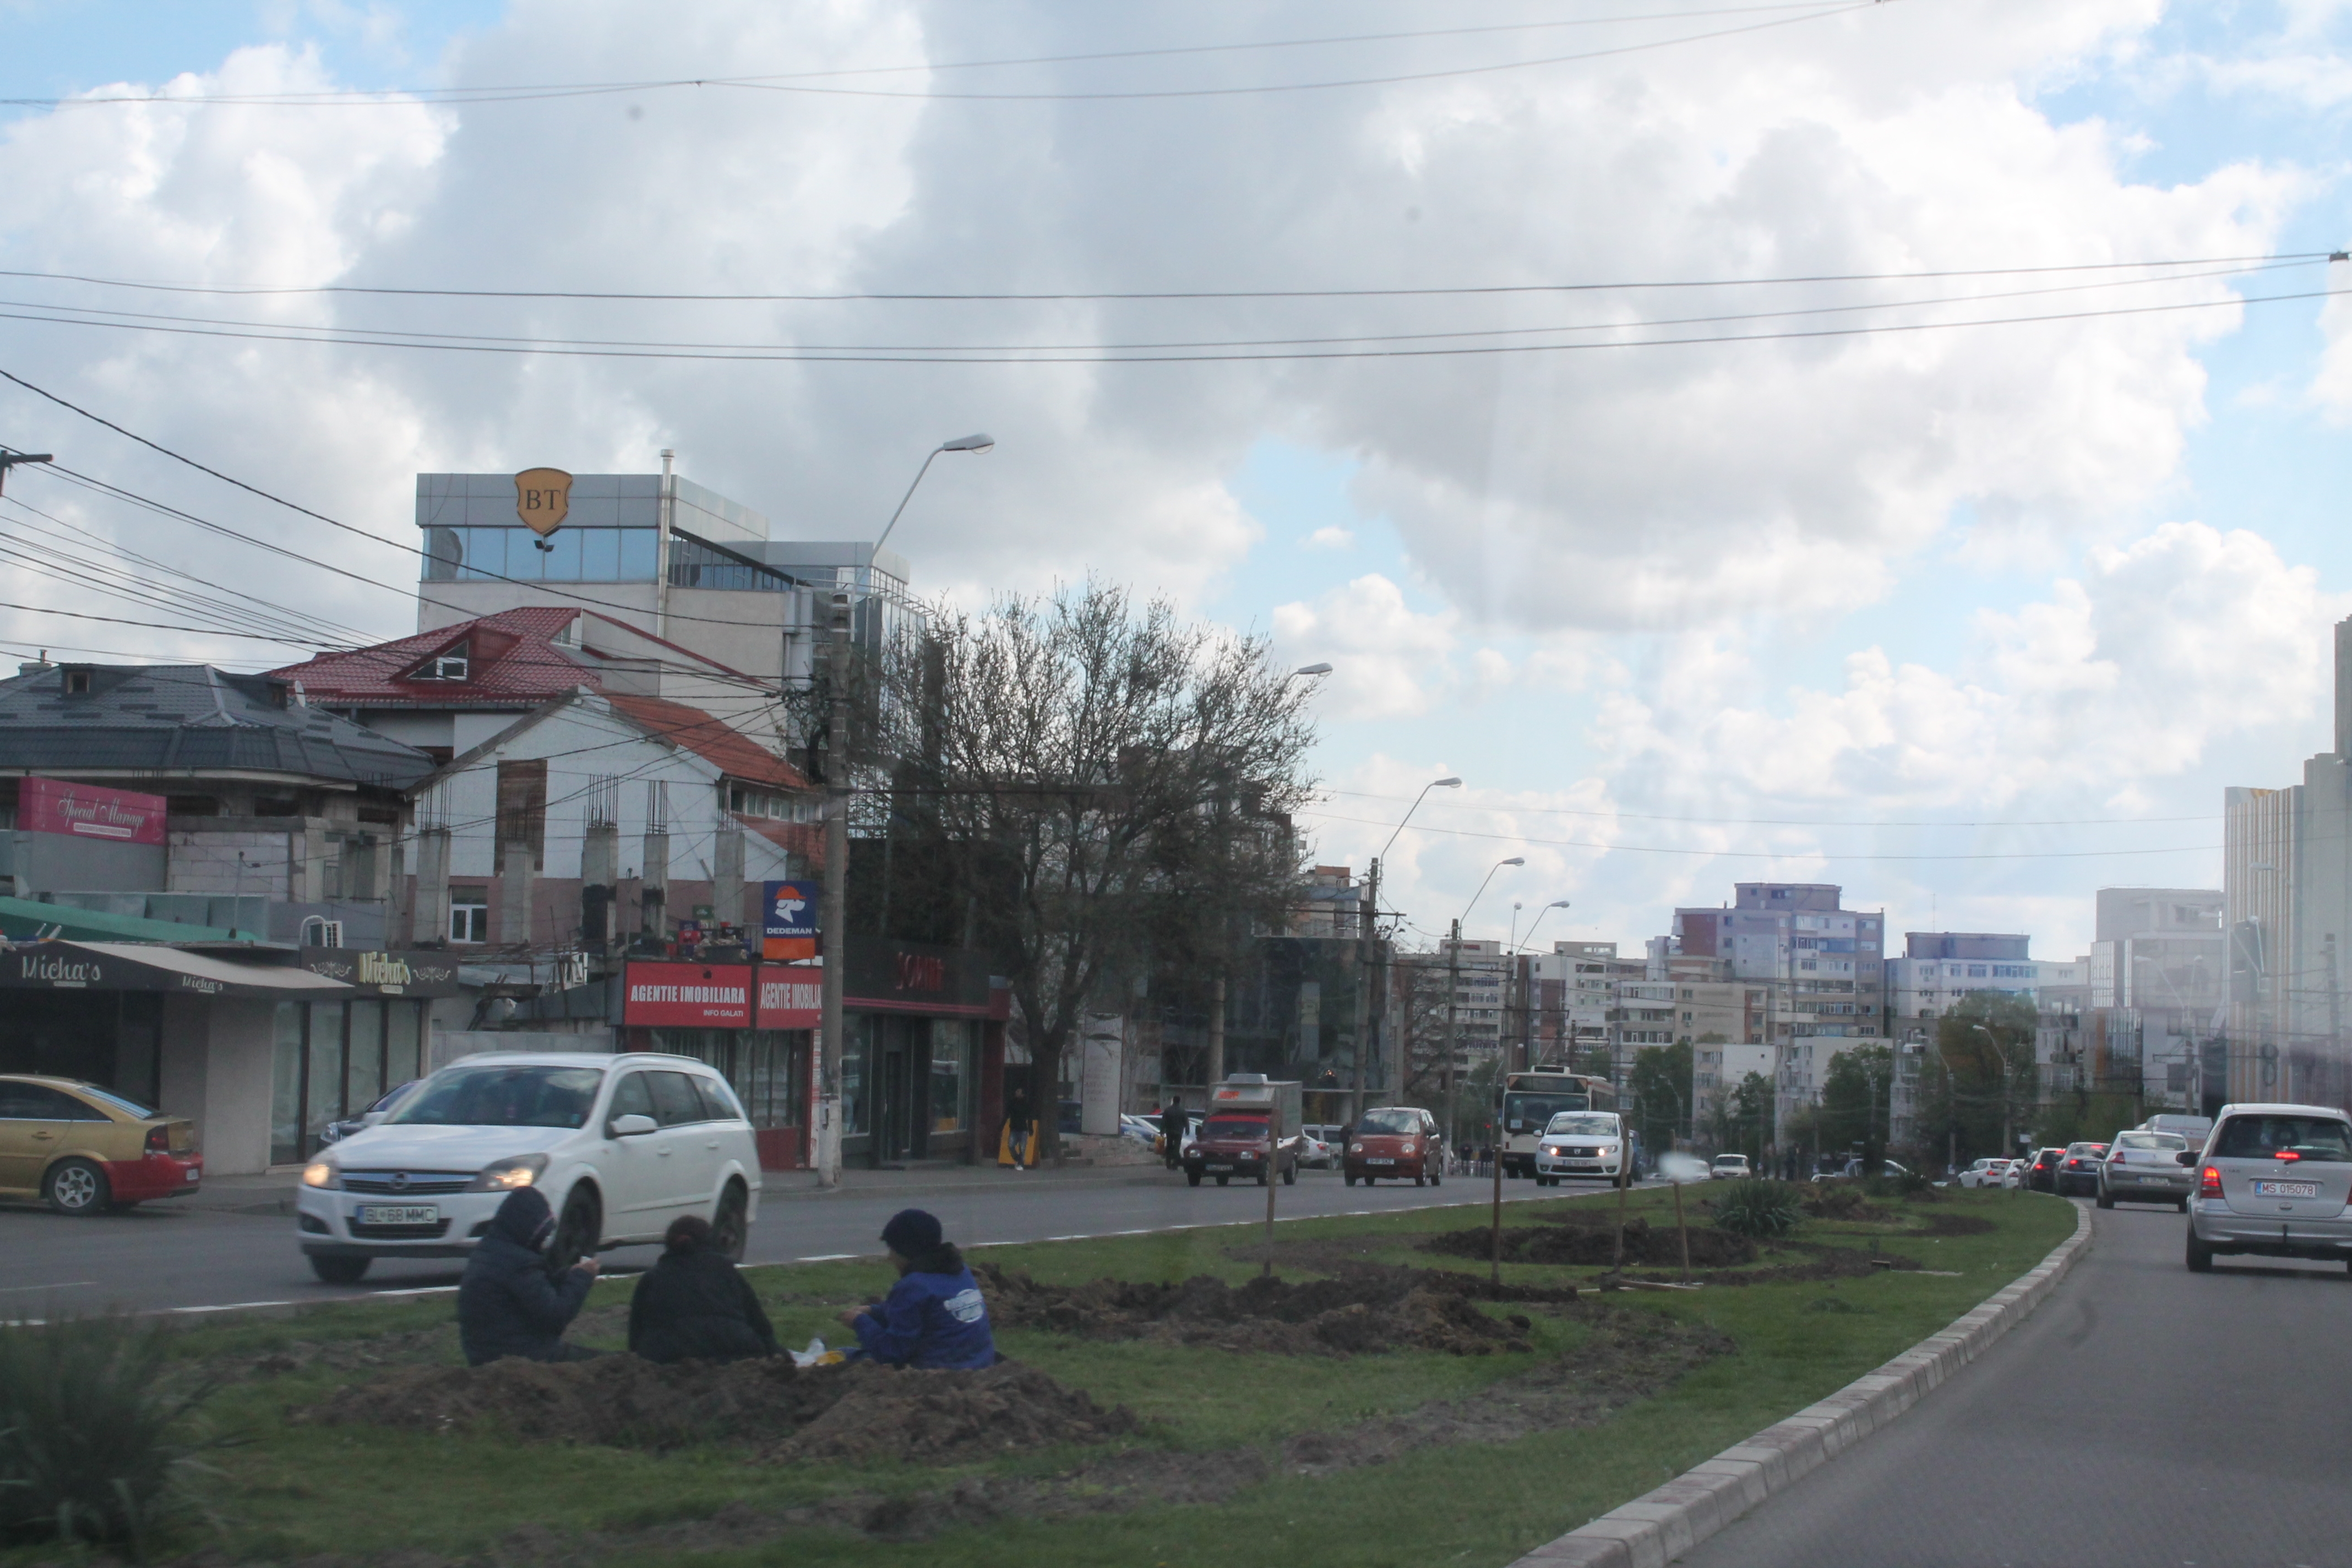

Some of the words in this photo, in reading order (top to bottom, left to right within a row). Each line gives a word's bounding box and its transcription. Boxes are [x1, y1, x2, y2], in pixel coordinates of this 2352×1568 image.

[526, 489, 560, 510] BT
[57, 789, 99, 826] Special
[100, 798, 145, 837] Mariage
[22, 955, 101, 981] Micha's
[358, 951, 411, 985] Micha's
[182, 976, 222, 990] Micha's
[630, 985, 678, 1002] AGENTIE
[680, 986, 745, 1004] IMOBILIARA
[760, 983, 791, 1009] AGENTIE
[792, 983, 822, 1009] IMOBILIA
[2263, 1183, 2276, 1193] MS
[2280, 1184, 2313, 1195] 015078
